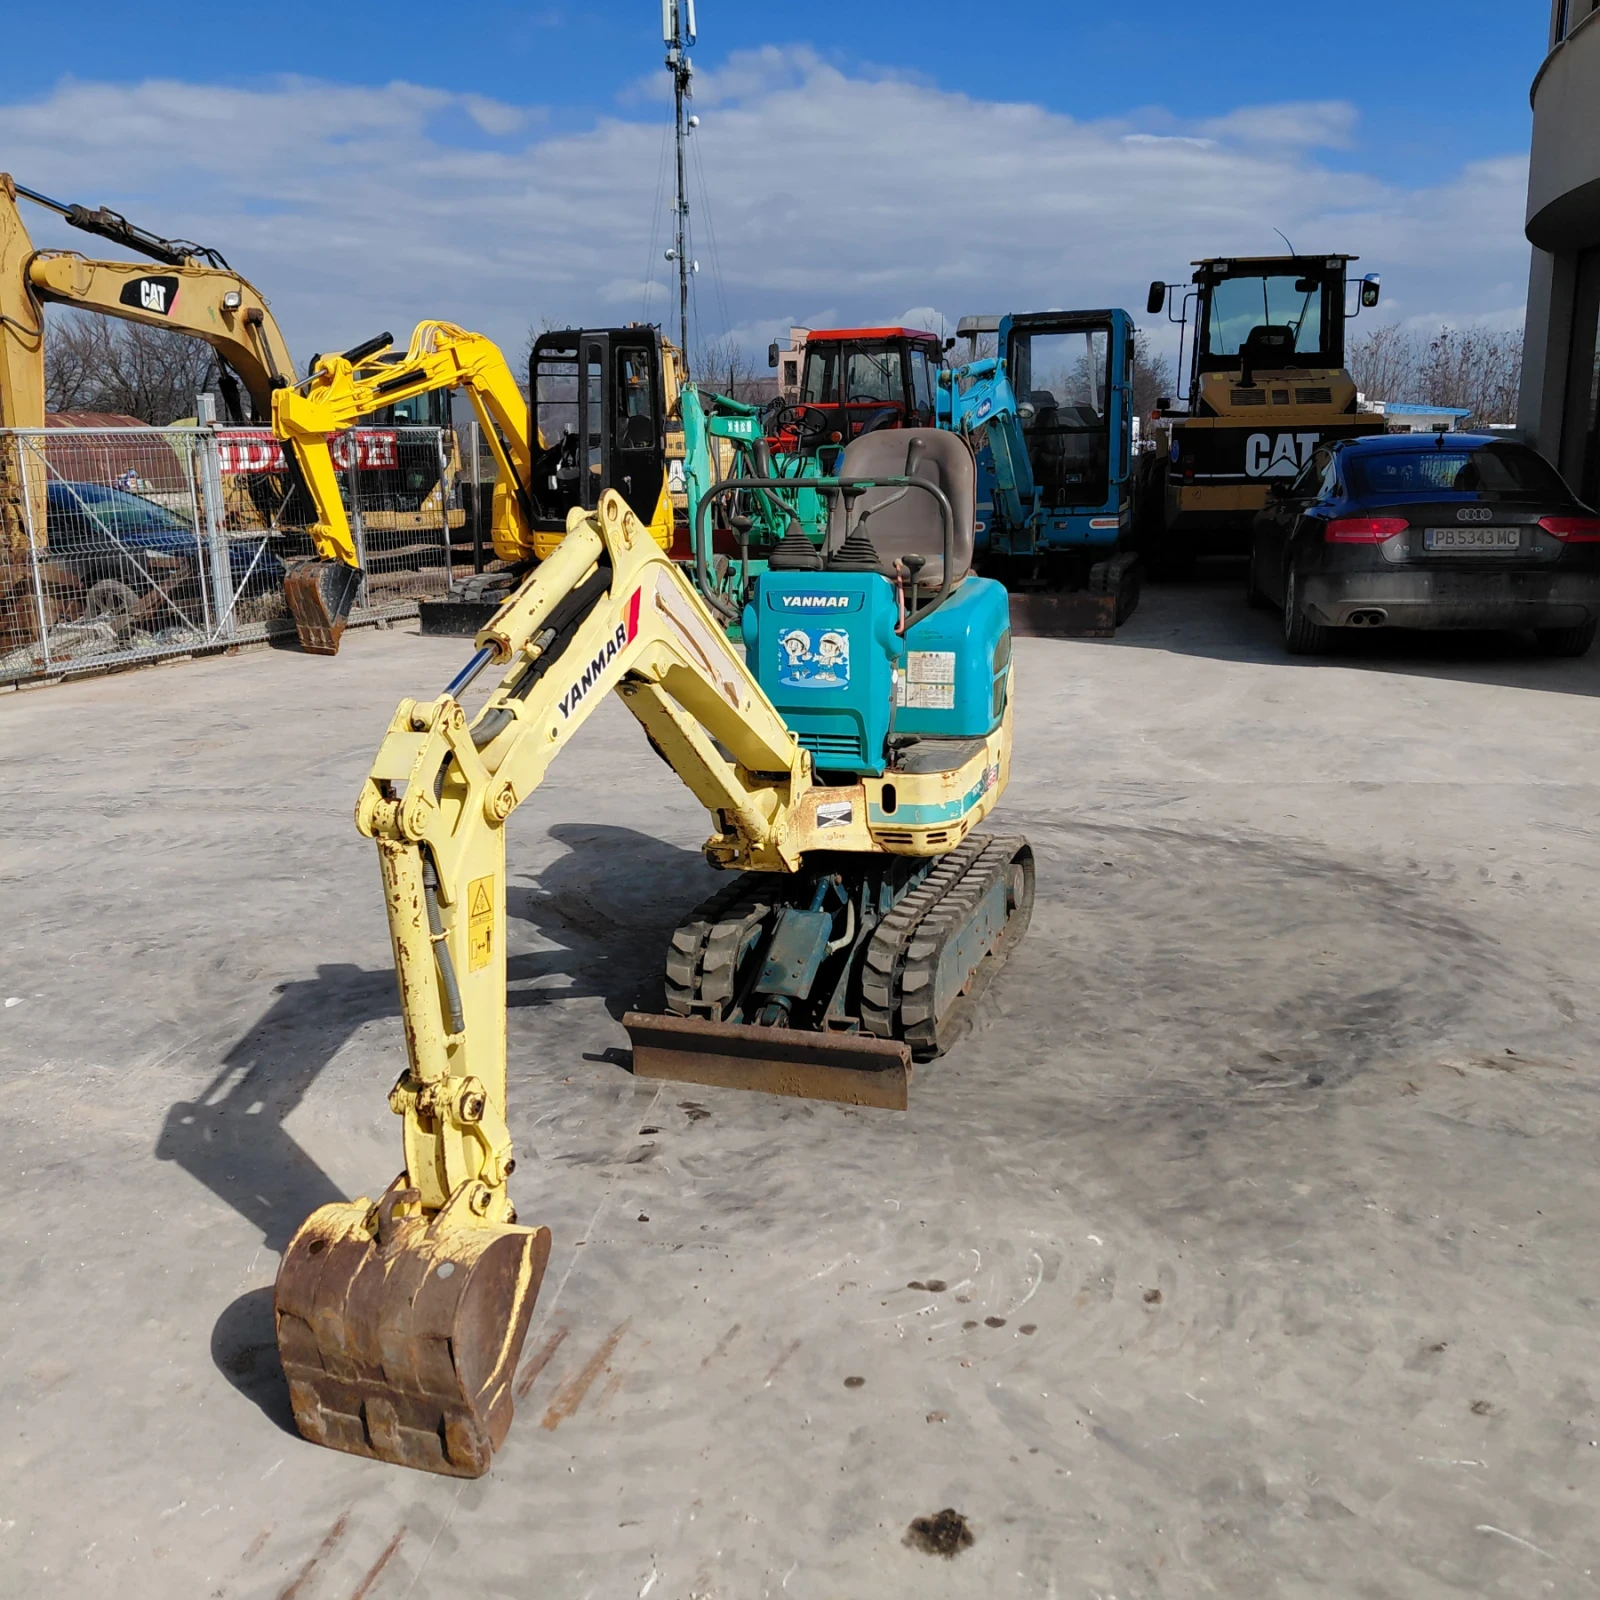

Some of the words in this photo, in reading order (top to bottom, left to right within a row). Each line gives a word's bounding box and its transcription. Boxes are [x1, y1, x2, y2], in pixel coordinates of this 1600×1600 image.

[141, 280, 166, 312] CAT
[1246, 433, 1320, 477] CAT
[1458, 531, 1494, 544] 5343
[782, 596, 849, 607] YANMAR
[558, 623, 627, 719] YANMAR
